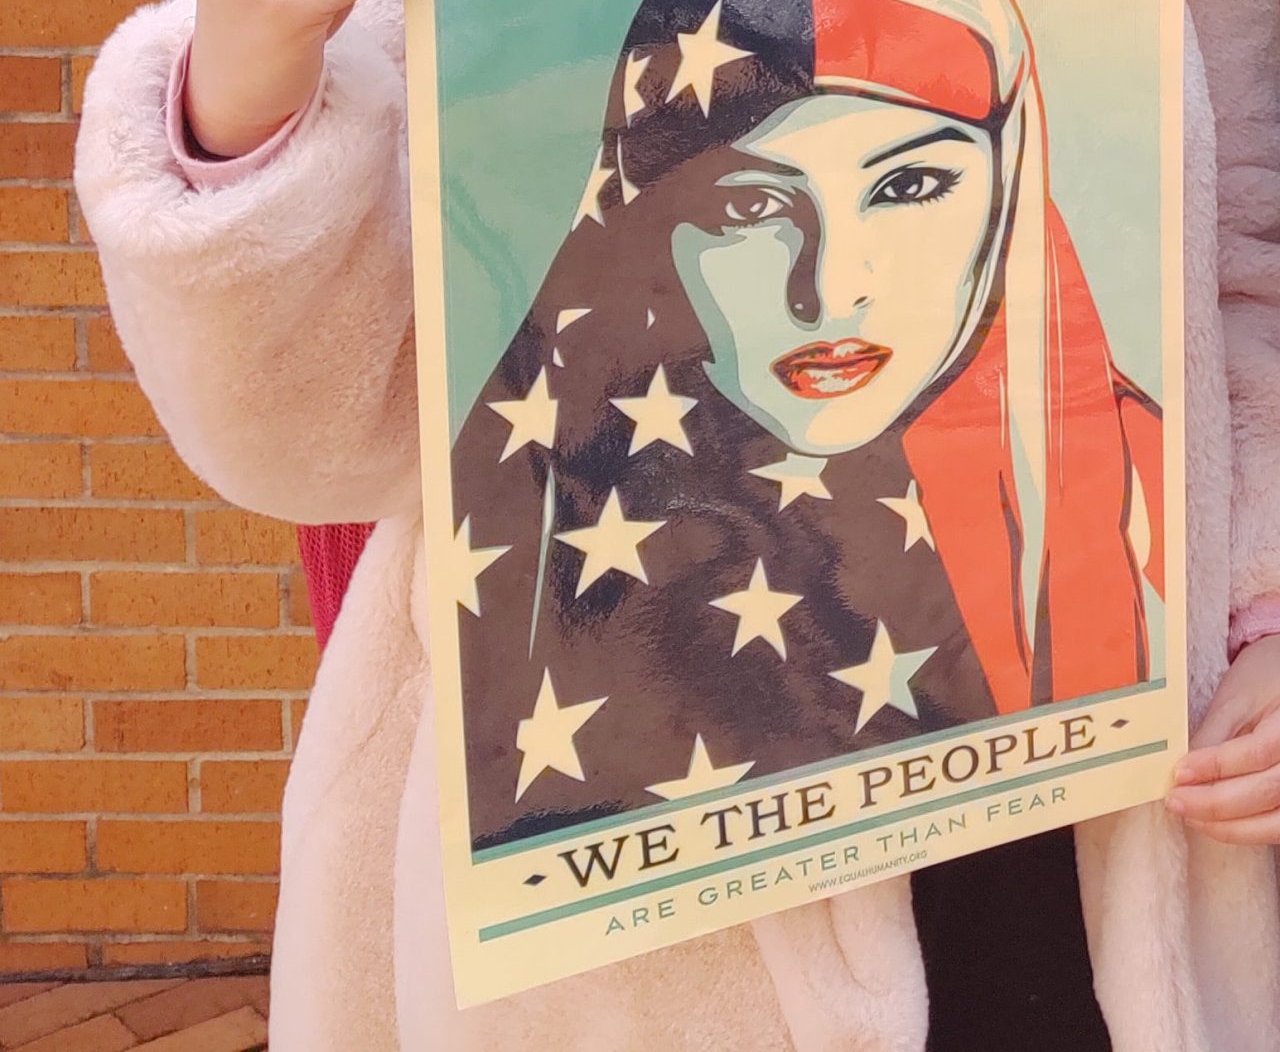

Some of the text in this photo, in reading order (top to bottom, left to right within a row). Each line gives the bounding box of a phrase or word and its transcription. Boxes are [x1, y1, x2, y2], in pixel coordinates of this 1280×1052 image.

[557, 714, 1097, 888] WE THE PEOPLE
[604, 786, 1067, 936] ARE GREATER THAN FEAR
[807, 850, 929, 893] WWW.EQUALHUMANITY.ORG
